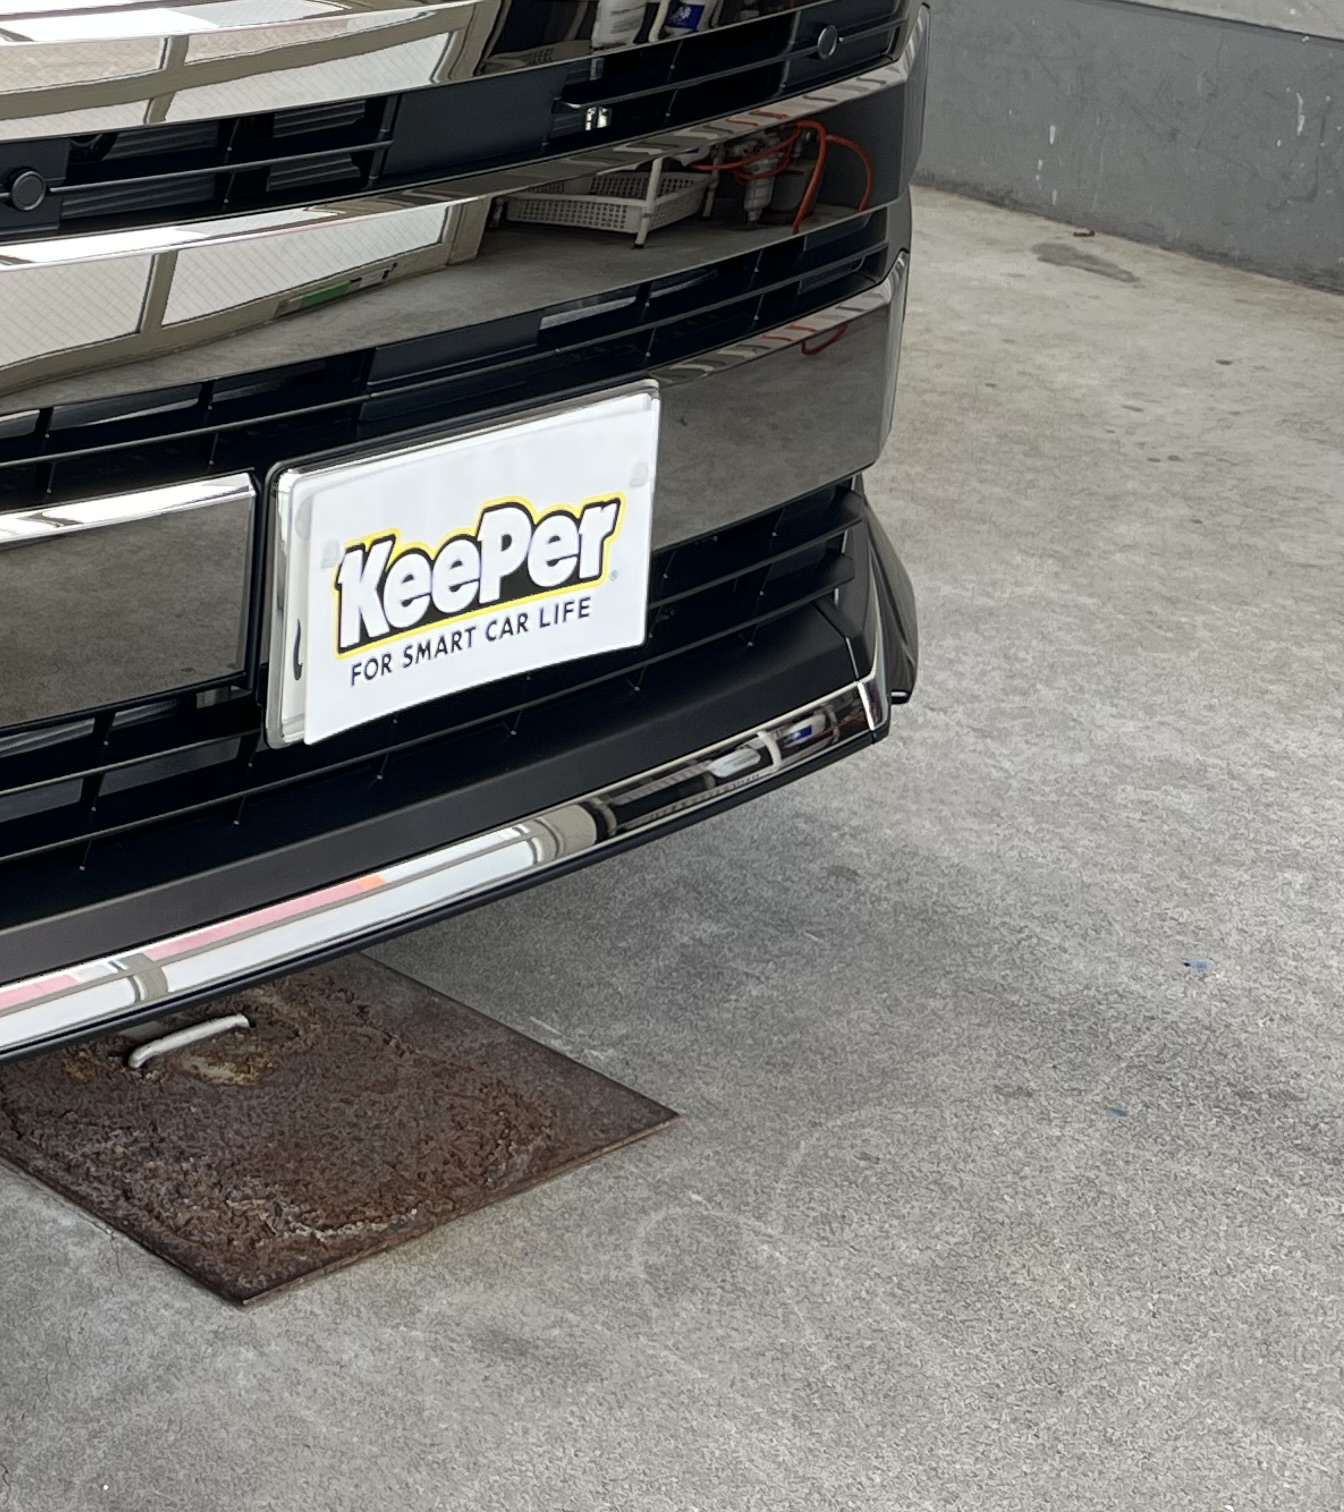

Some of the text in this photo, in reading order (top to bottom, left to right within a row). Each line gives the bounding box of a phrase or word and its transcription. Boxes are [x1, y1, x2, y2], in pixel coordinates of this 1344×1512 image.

[334, 497, 622, 654] KeePer
[350, 596, 592, 687] FOR SMART CAR LIFE
